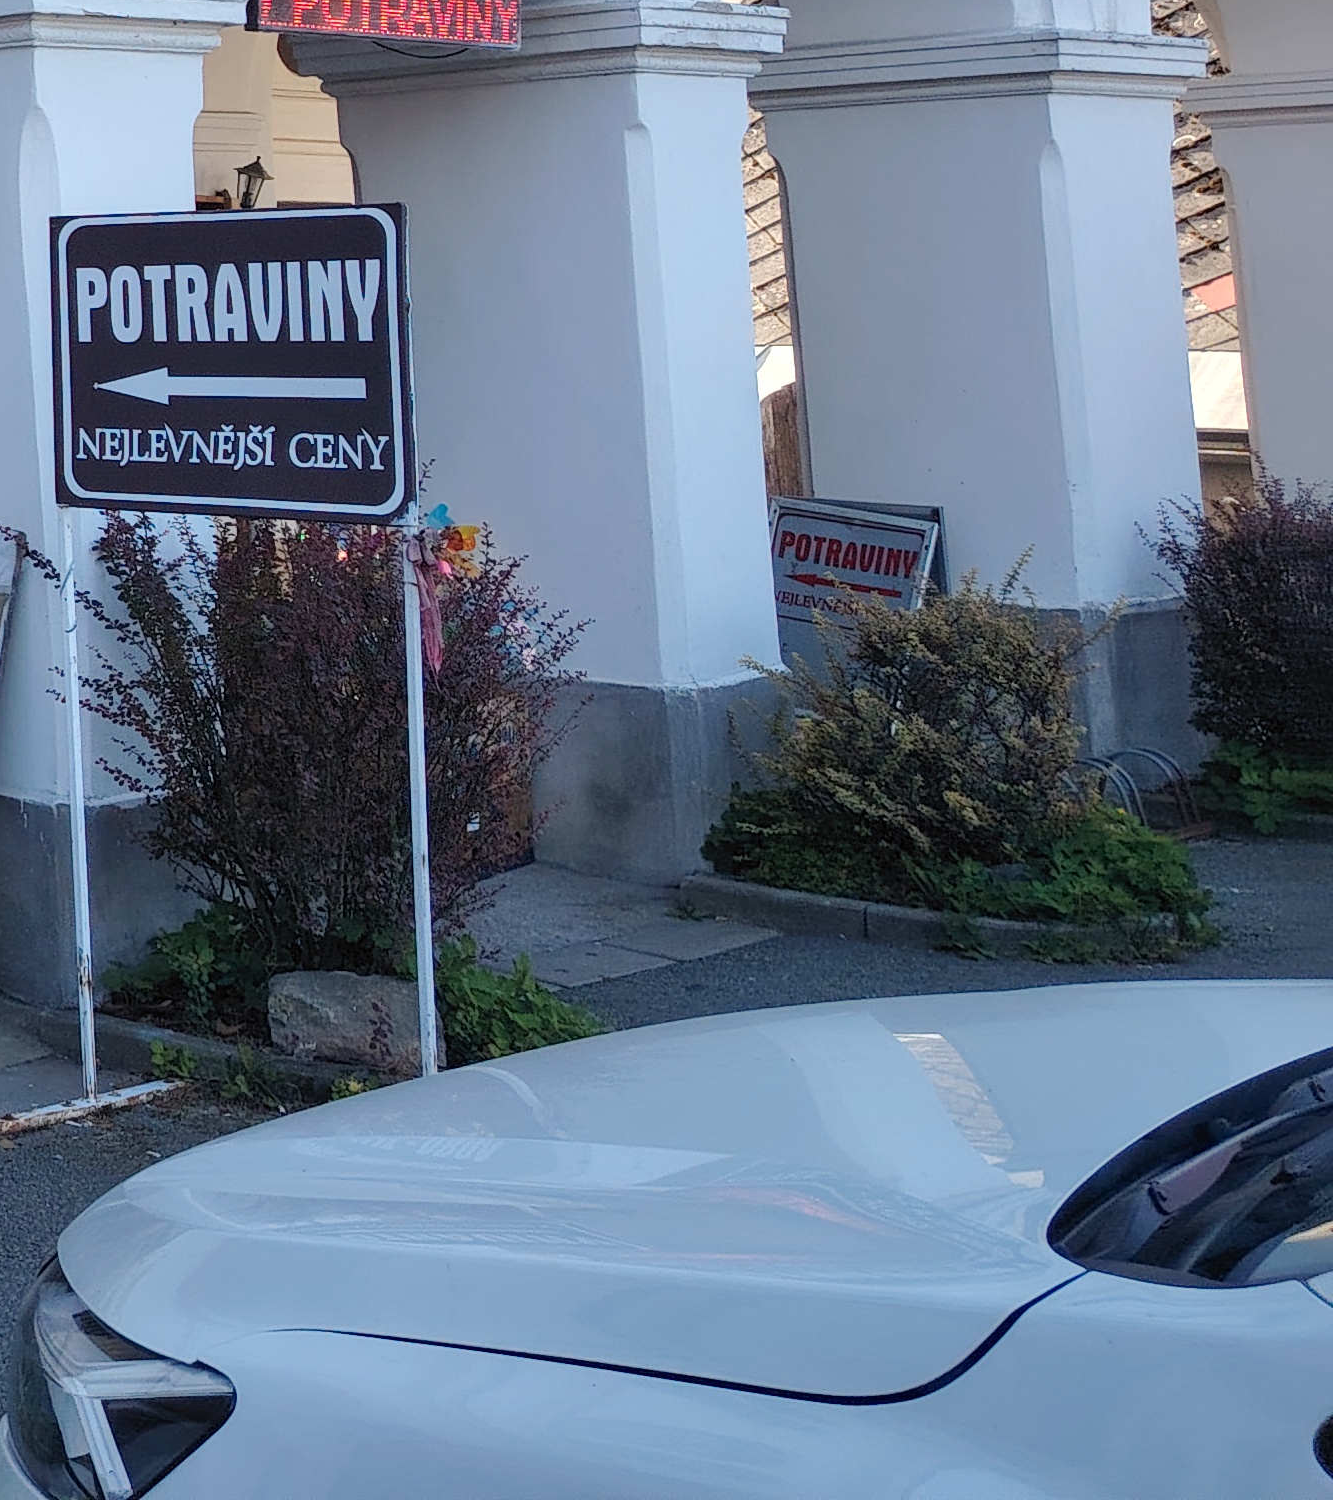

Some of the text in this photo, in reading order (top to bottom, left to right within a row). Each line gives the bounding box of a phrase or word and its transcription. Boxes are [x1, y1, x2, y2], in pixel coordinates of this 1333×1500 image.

[75, 258, 381, 343] POTRAVINY
[75, 422, 390, 471] NEJLEVNĚJŠÍ CENY
[777, 530, 919, 579] POTRAVINY
